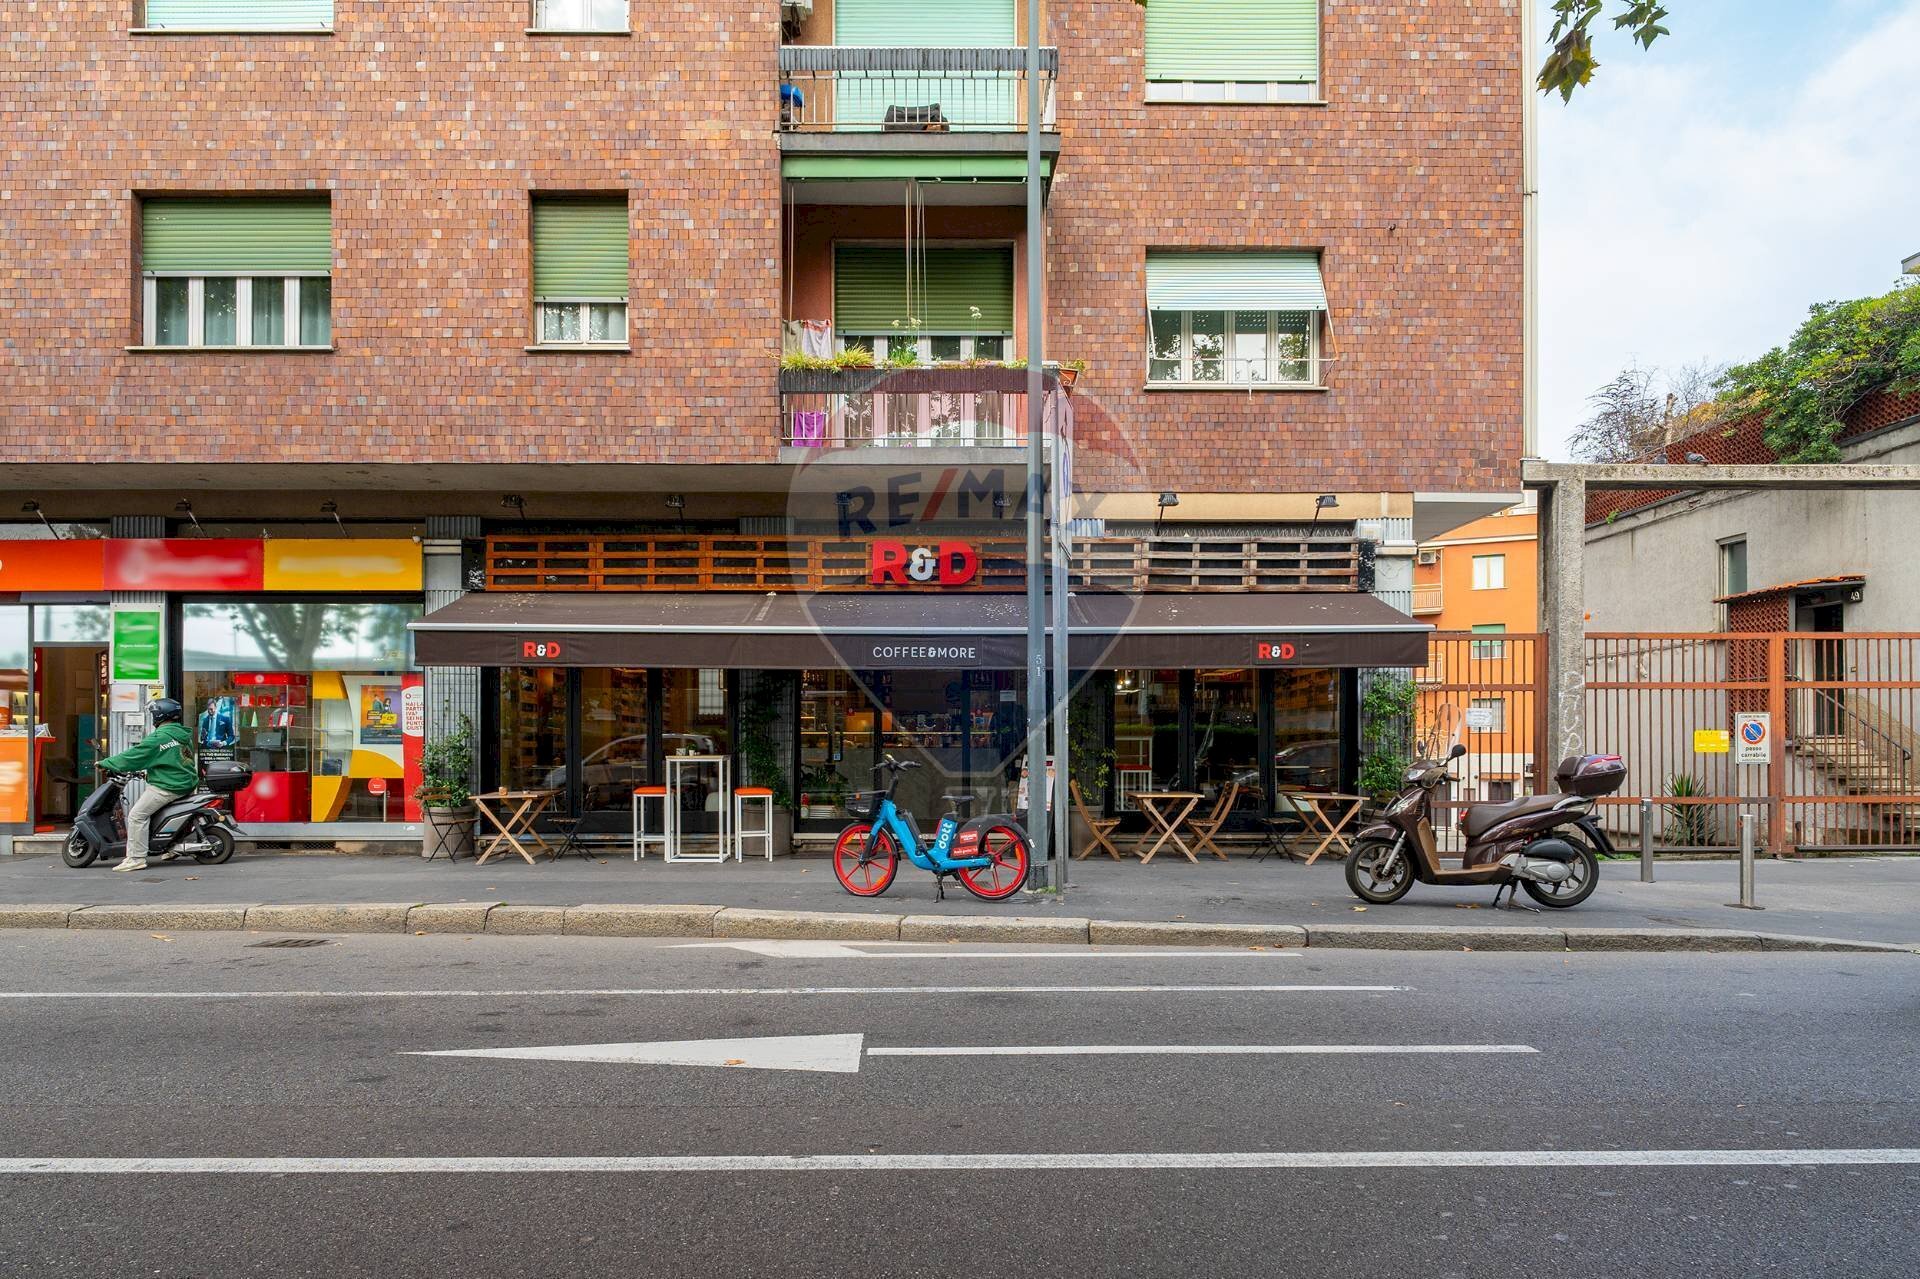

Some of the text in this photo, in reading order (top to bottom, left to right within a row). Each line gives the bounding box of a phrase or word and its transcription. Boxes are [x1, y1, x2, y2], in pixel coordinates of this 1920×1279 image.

[871, 540, 978, 586] R&D
[1850, 591, 1860, 601] 49
[523, 641, 561, 659] R&D
[872, 646, 976, 660] COFFEE&MORE
[1258, 641, 1295, 660] R&D
[938, 822, 953, 849] dott
